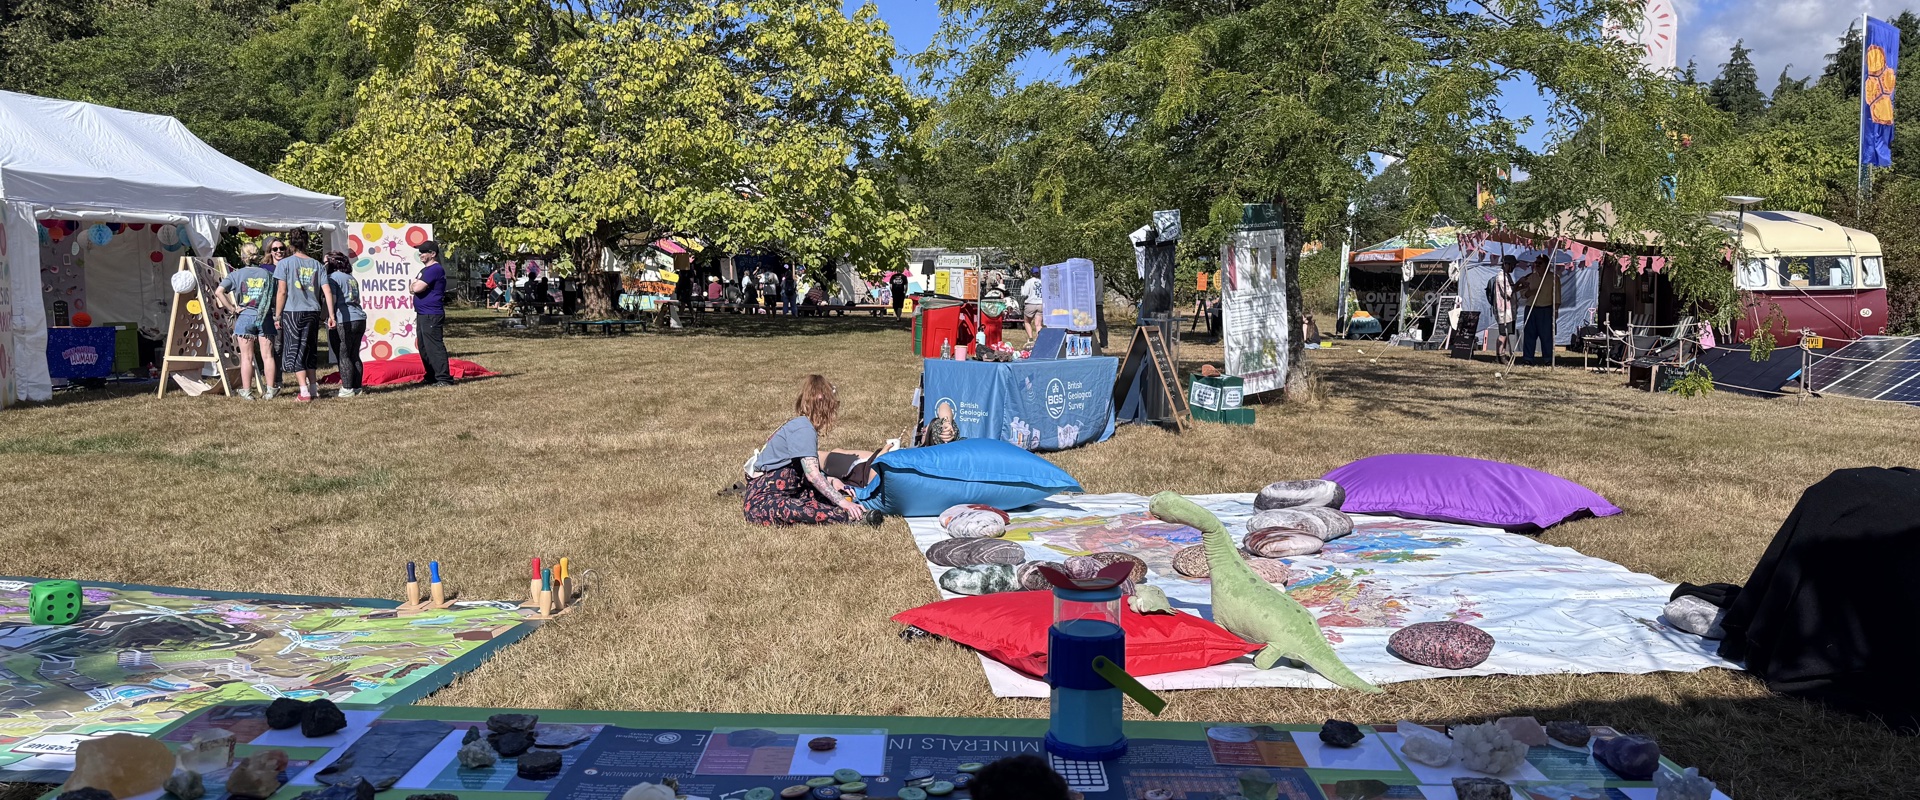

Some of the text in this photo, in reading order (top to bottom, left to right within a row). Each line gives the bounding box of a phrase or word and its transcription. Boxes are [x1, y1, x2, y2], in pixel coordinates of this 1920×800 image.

[943, 256, 970, 265] Recycling Point
[375, 260, 411, 275] WHAT
[362, 279, 406, 292] MAKES
[1067, 380, 1083, 390] British
[1047, 395, 1063, 405] BGS
[1067, 389, 1093, 401] Geological
[959, 401, 979, 409] British
[1068, 401, 1085, 411] Survey
[959, 415, 981, 424] Survey
[888, 737, 1040, 753] MINERALS IN
